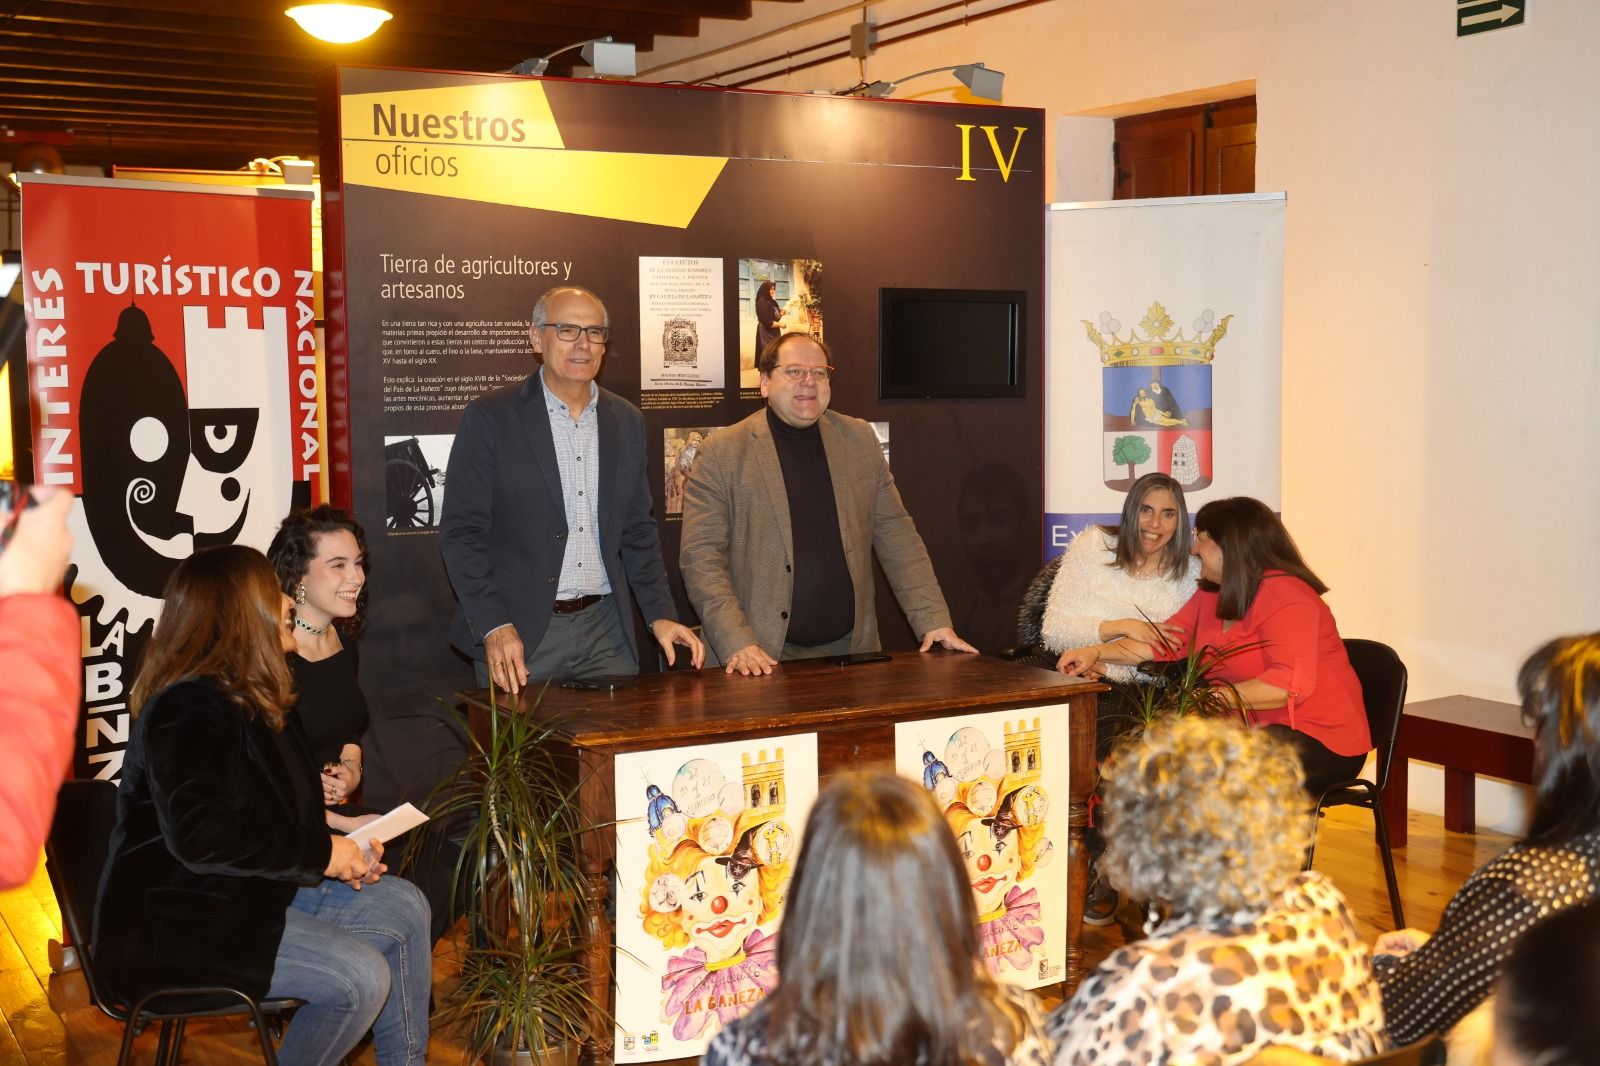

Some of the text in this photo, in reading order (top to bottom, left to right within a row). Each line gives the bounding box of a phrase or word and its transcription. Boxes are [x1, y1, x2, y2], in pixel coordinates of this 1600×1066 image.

[372, 103, 526, 143] Nuestros
[375, 145, 459, 177] oficios
[955, 124, 1028, 183] IV
[75, 254, 281, 298] TURÍSTICO
[380, 253, 572, 281] Tierra de agricultores y
[381, 281, 465, 299] artesanos
[406, 330, 424, 338] primas
[466, 320, 492, 328] agricultura
[27, 267, 74, 485] INTERÉS
[293, 269, 321, 482] NACIONAL
[81, 616, 125, 658] LA
[685, 998, 703, 1015] LA
